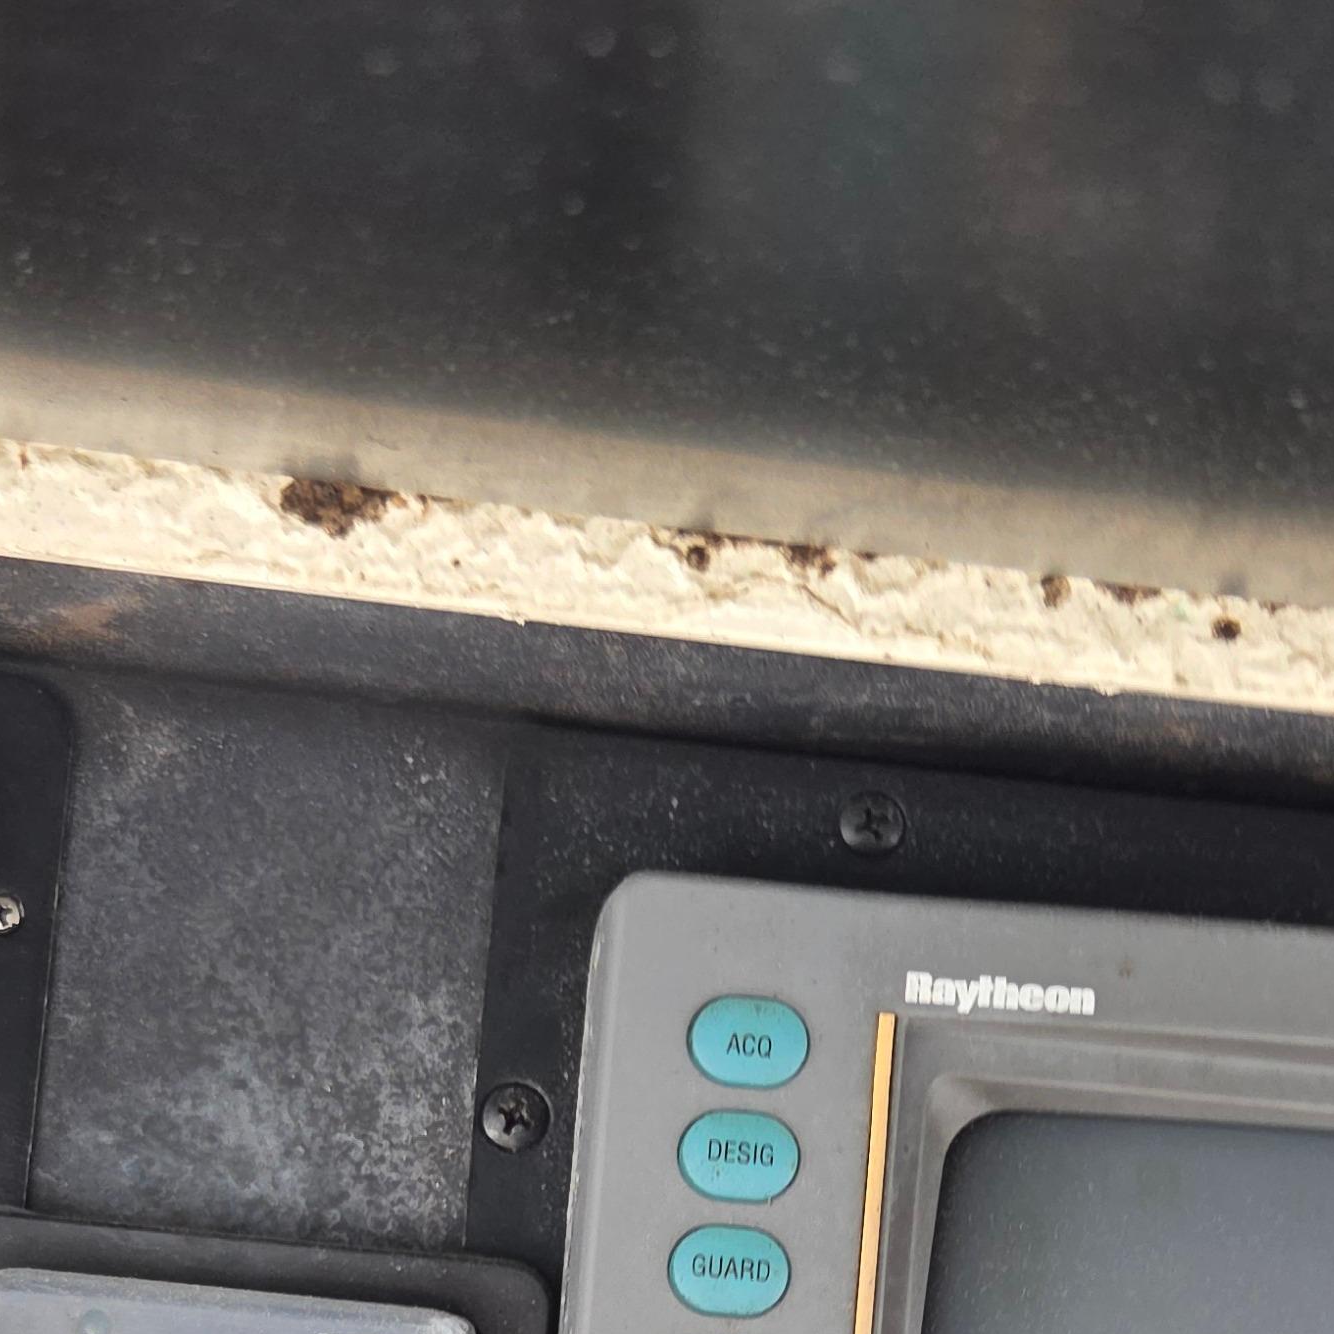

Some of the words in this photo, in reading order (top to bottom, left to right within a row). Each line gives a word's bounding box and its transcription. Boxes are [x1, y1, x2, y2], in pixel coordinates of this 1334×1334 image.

[905, 970, 1095, 1015] Raytheon
[726, 1032, 772, 1058] ACQ
[707, 1138, 774, 1167] DESIG
[691, 1253, 771, 1283] GUARD
